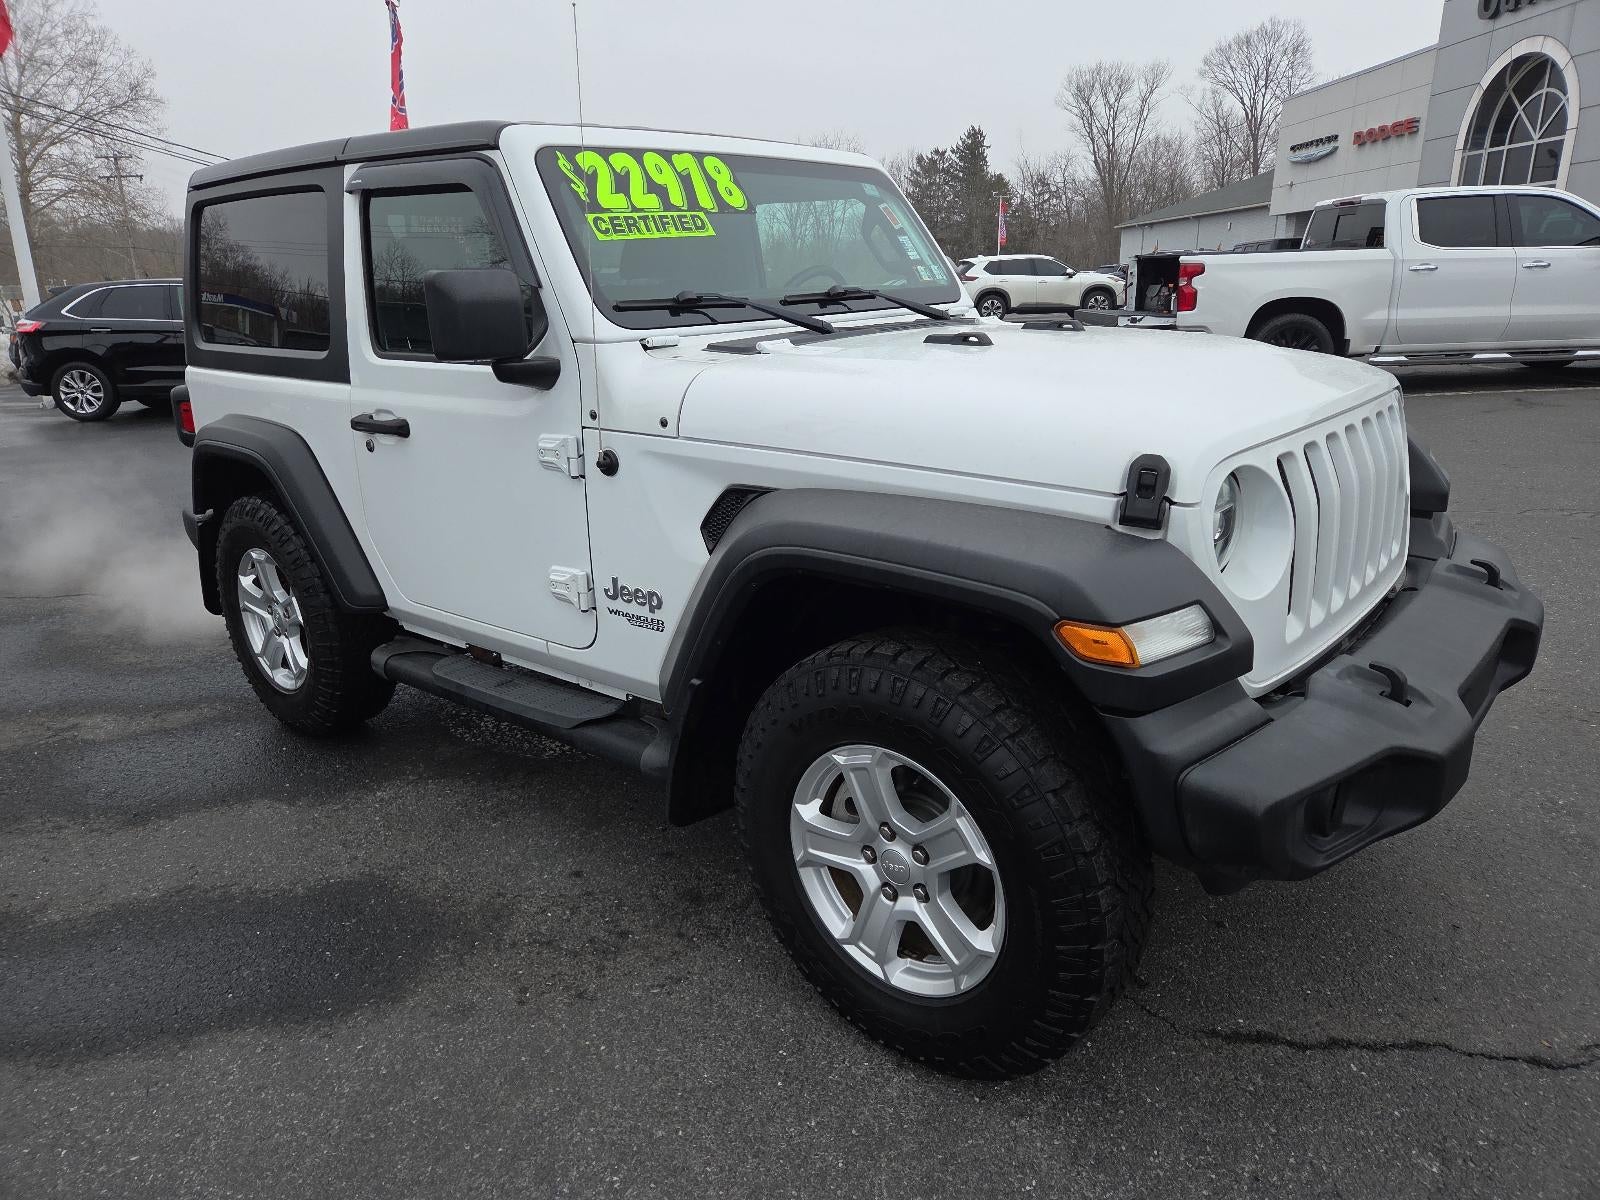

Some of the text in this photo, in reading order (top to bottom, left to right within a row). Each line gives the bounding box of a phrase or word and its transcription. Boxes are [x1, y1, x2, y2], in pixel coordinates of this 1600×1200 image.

[1353, 117, 1420, 146] DODGE
[556, 150, 748, 213] $22978
[592, 214, 706, 236] CERTIFIED
[604, 576, 663, 614] Jeep
[607, 607, 665, 626] WRANGLER
